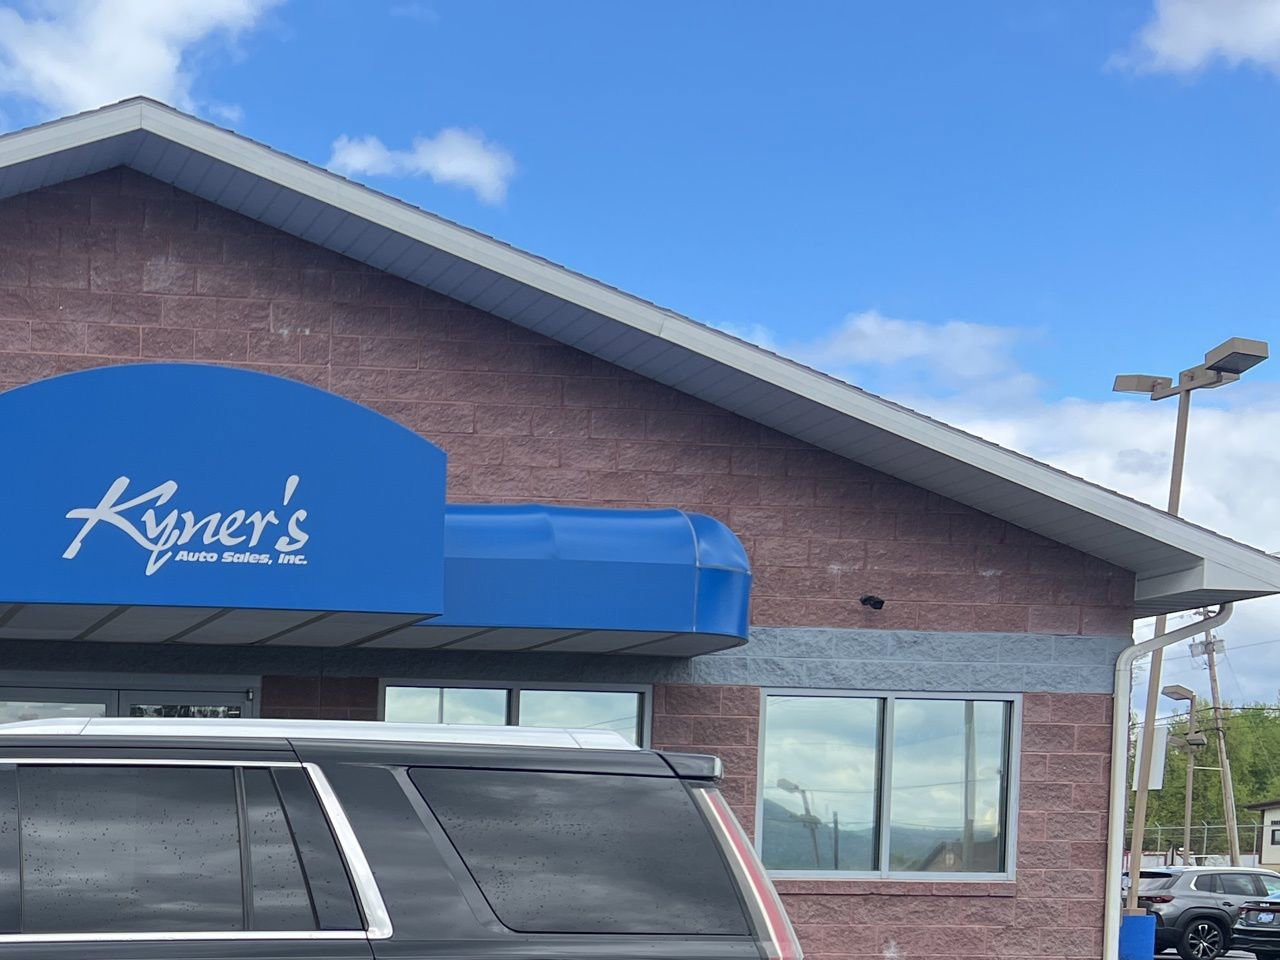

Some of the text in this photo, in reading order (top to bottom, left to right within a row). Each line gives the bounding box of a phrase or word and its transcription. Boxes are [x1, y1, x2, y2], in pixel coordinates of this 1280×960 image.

[62, 474, 309, 576] Kyner's
[174, 550, 308, 565] Auto Sales, Inc.
